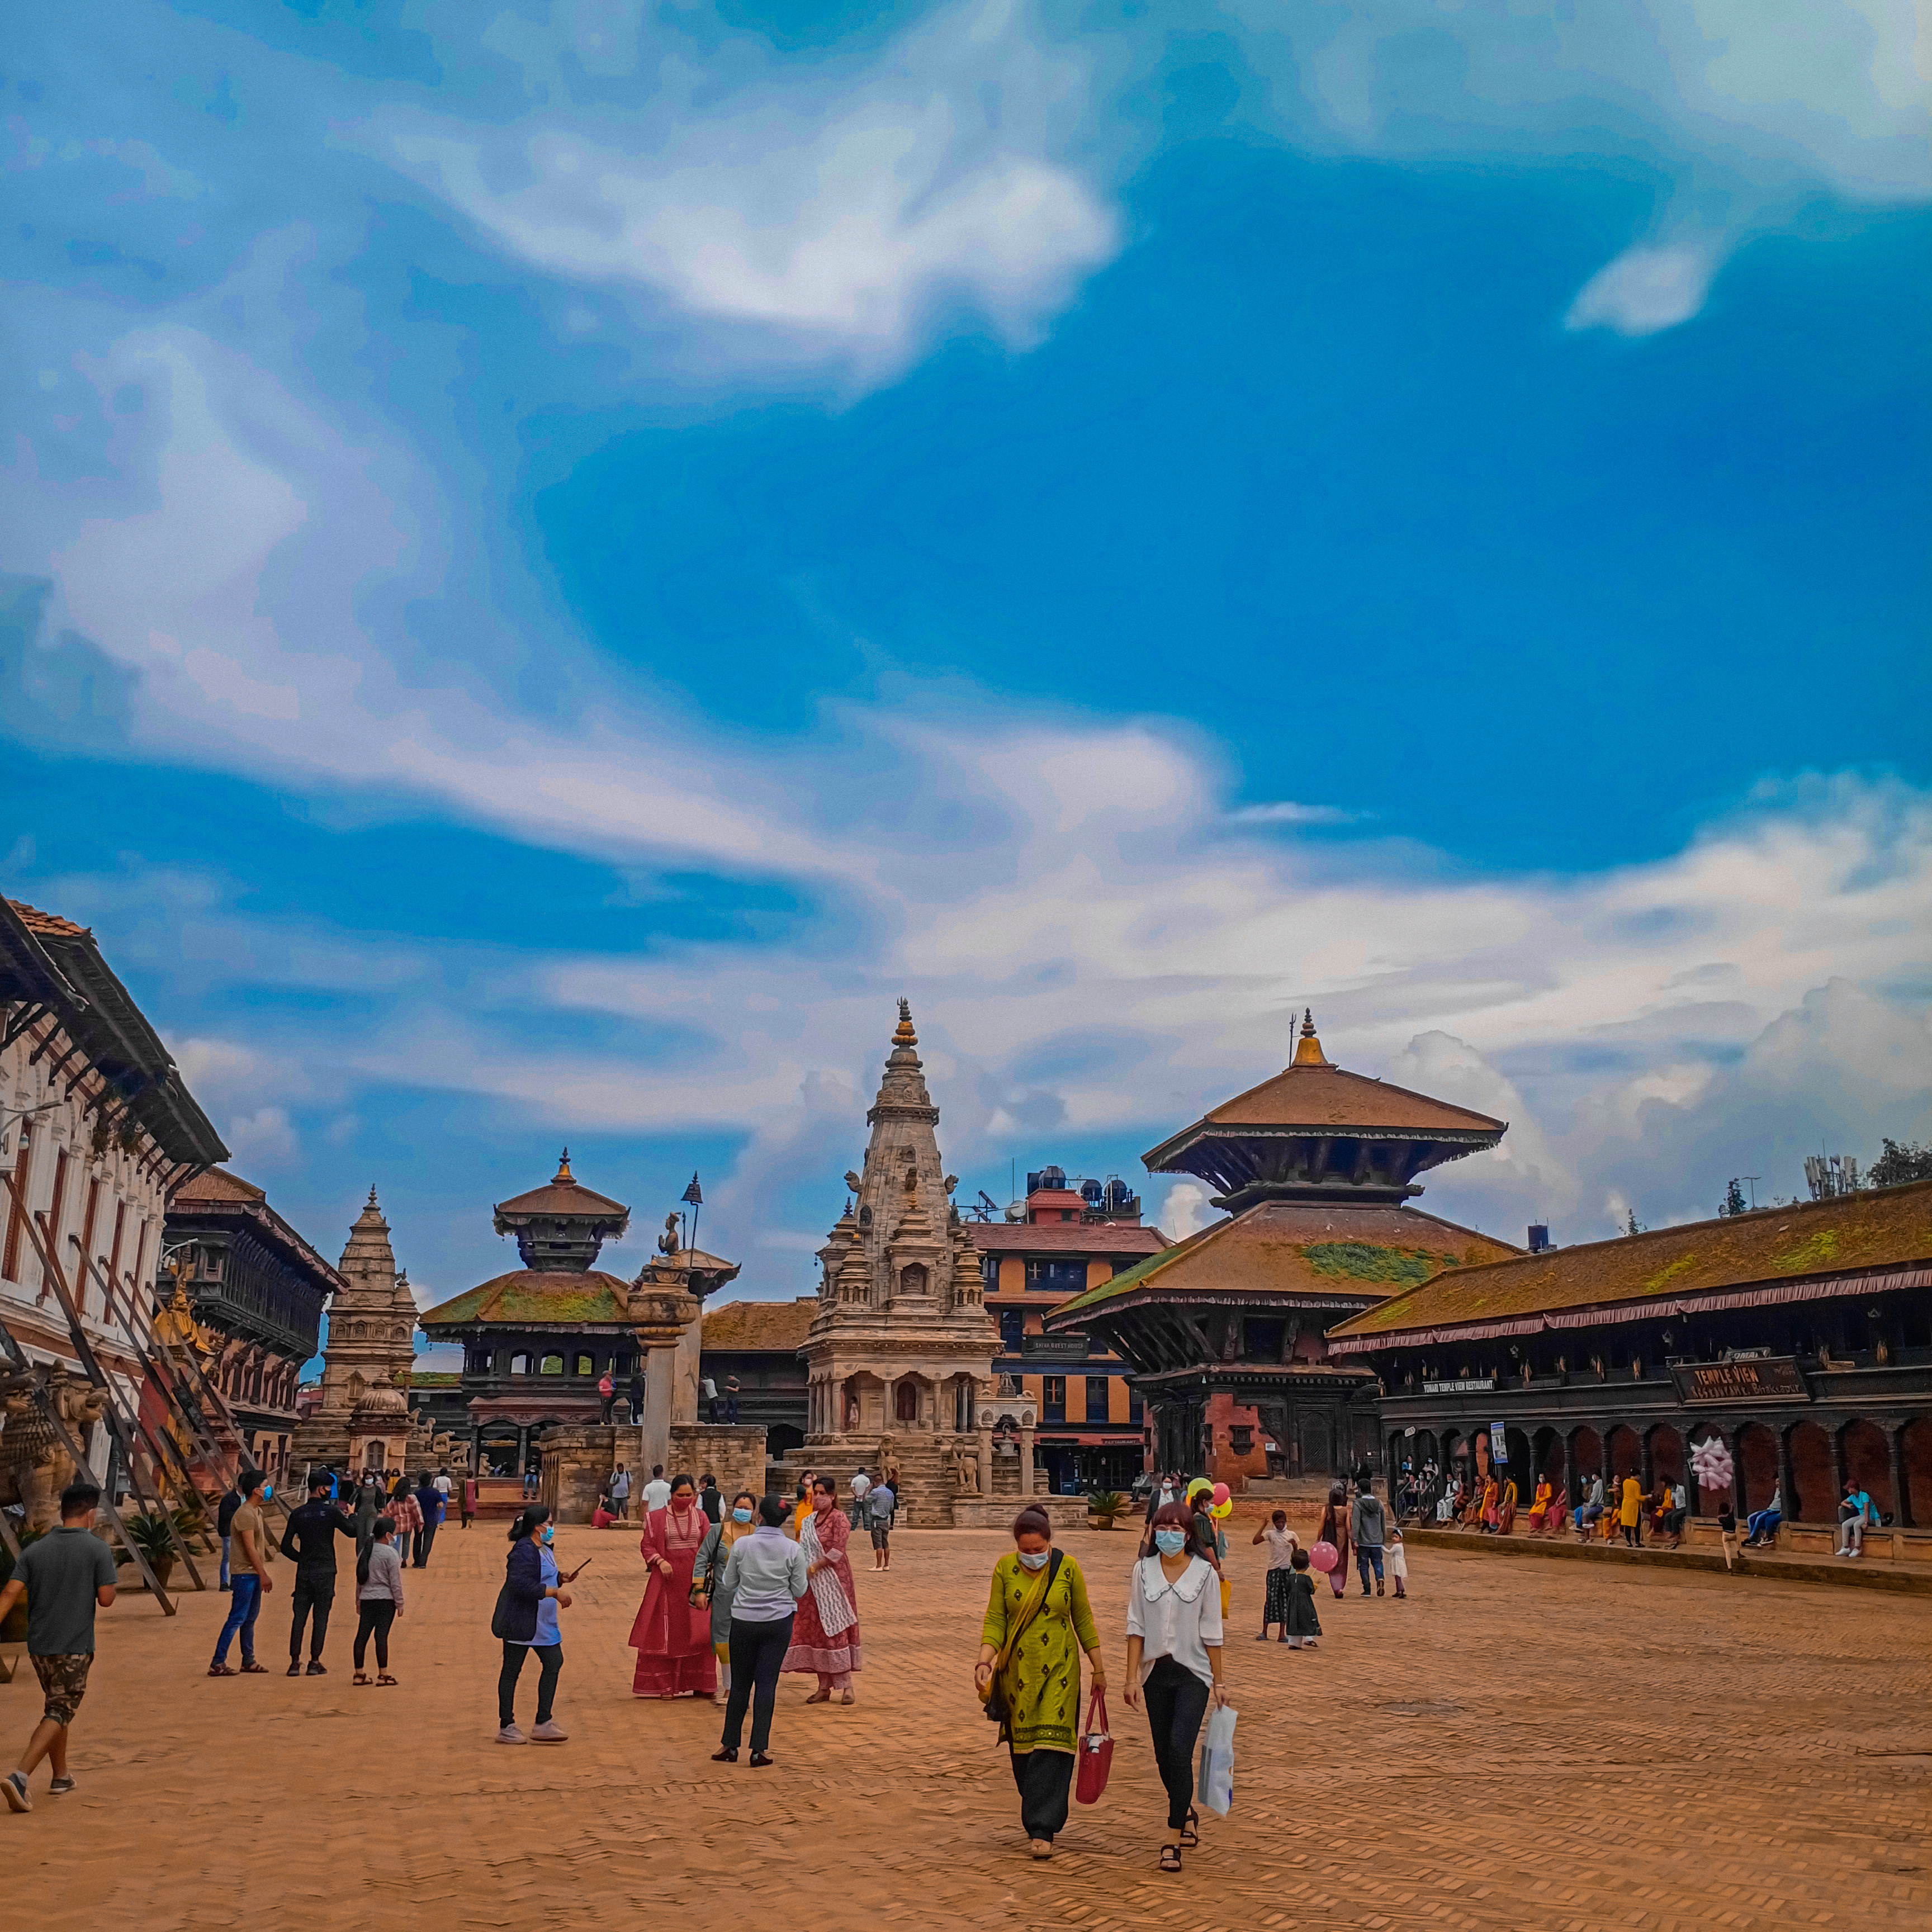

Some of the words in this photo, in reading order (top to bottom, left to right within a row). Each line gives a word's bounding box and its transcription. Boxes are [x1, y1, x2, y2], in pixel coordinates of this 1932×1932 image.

[1694, 1368, 1733, 1385] TEMPLE
[1733, 1367, 1759, 1382] VIEW
[1439, 1382, 1455, 1392] TEMPLE
[1455, 1381, 1465, 1391] VIEW
[1466, 1380, 1493, 1390] RESTAURANT
